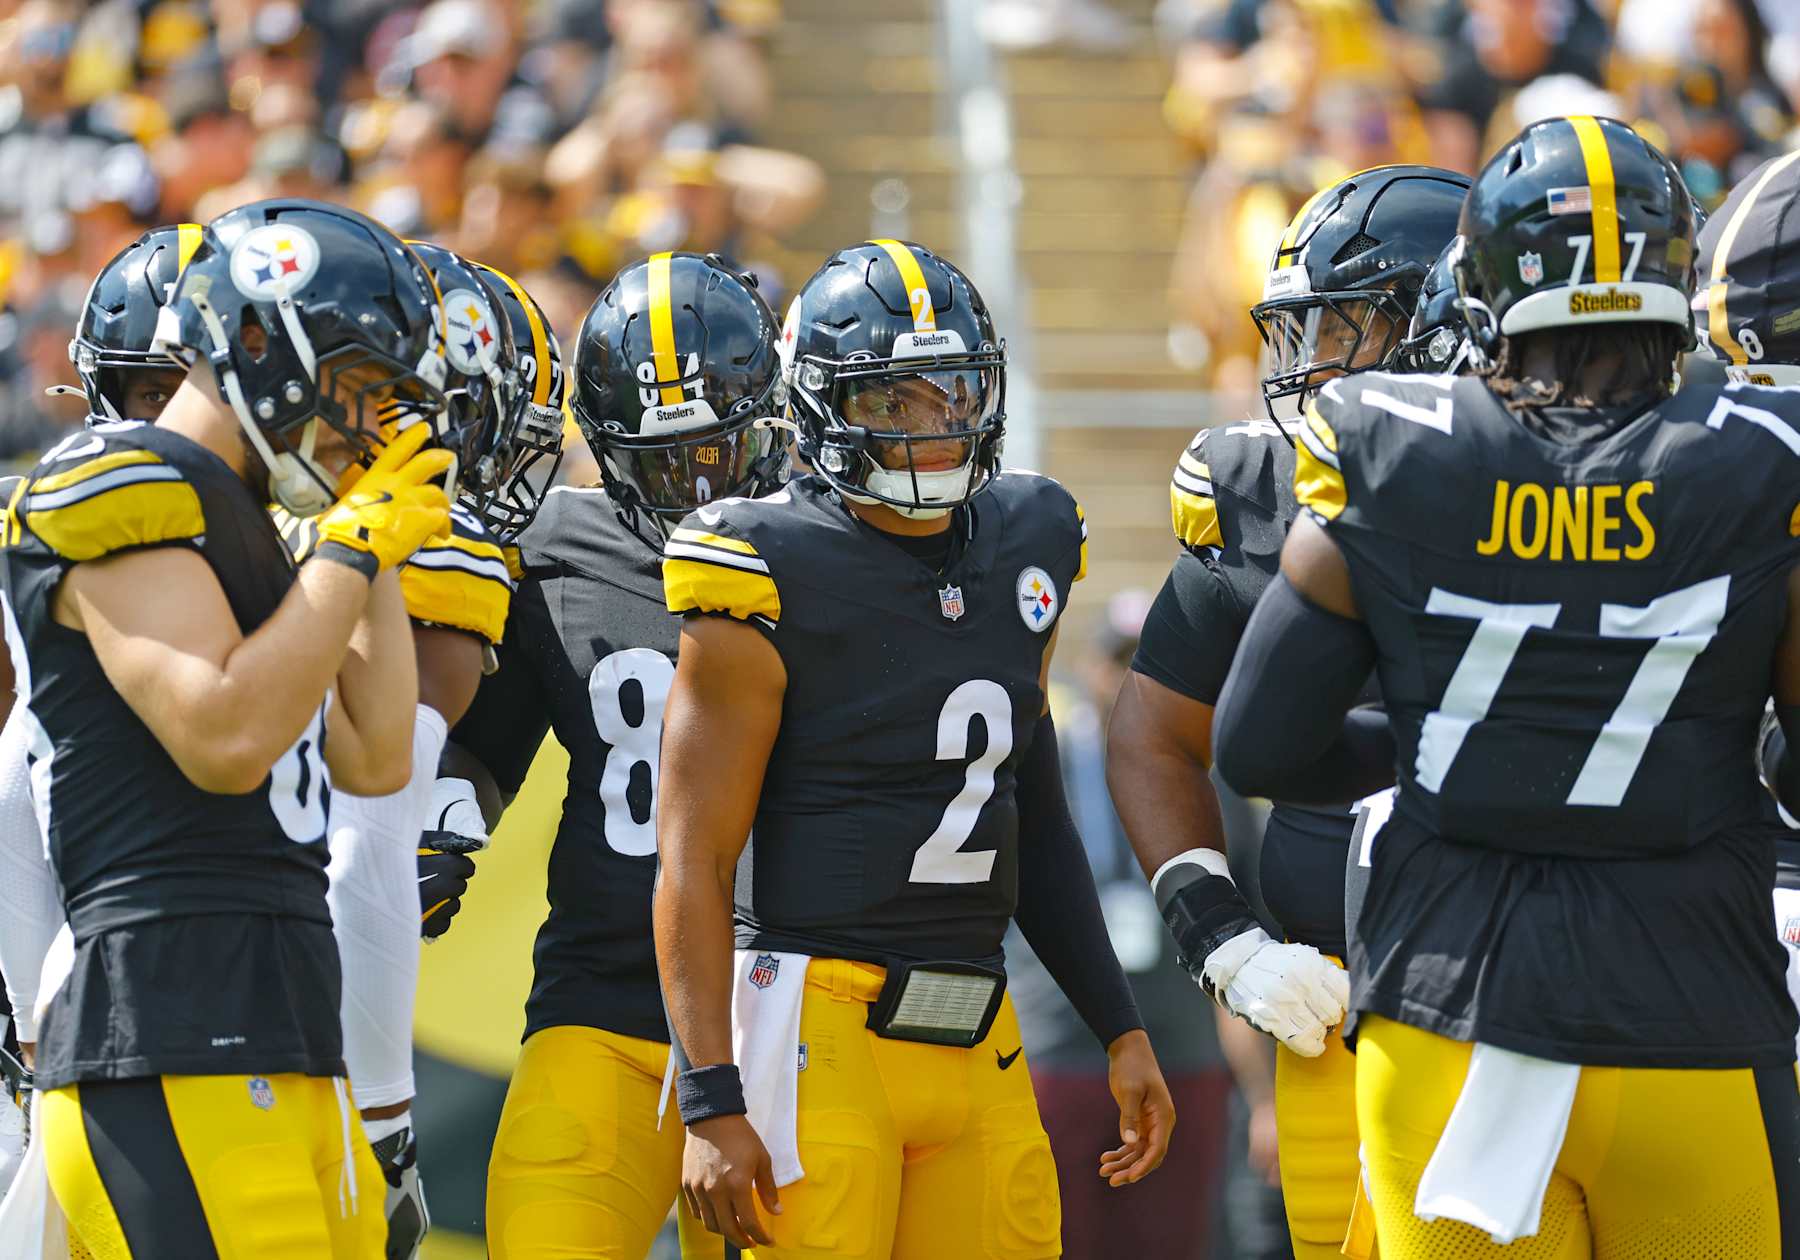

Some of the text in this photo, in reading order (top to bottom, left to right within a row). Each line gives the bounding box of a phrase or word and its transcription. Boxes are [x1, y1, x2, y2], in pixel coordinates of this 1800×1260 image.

[1567, 232, 1647, 286] 77
[911, 288, 936, 331] 2
[1569, 287, 1642, 315] Steelers
[912, 334, 951, 347] Steelers
[636, 352, 705, 408] 84
[656, 406, 695, 421] Steelers
[1476, 480, 1656, 563] JONES
[944, 600, 961, 614] NFL
[1415, 574, 1730, 807] 77
[908, 679, 1013, 884] 2
[751, 967, 774, 985] NFL
